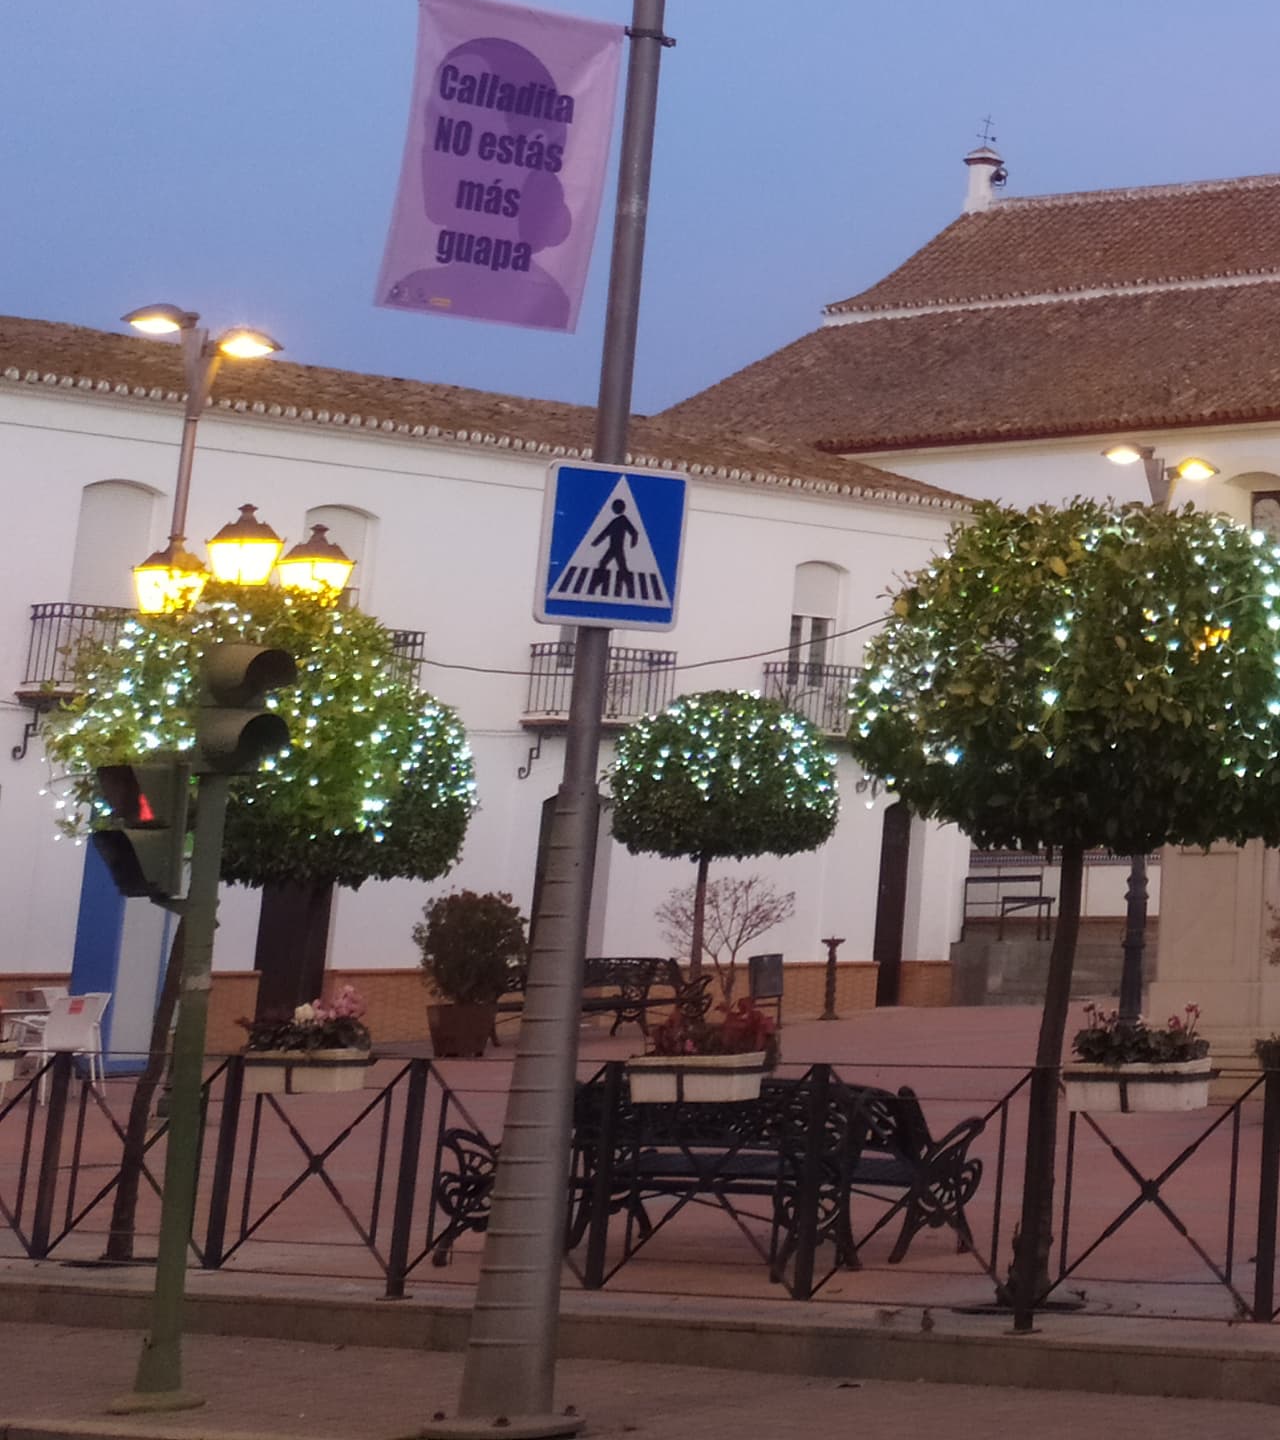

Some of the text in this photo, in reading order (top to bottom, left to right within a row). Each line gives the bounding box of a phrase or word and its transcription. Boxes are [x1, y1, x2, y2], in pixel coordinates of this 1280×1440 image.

[439, 64, 575, 124] Calladita
[434, 116, 564, 174] NO estás
[455, 178, 521, 219] más
[435, 229, 532, 272] guapa
